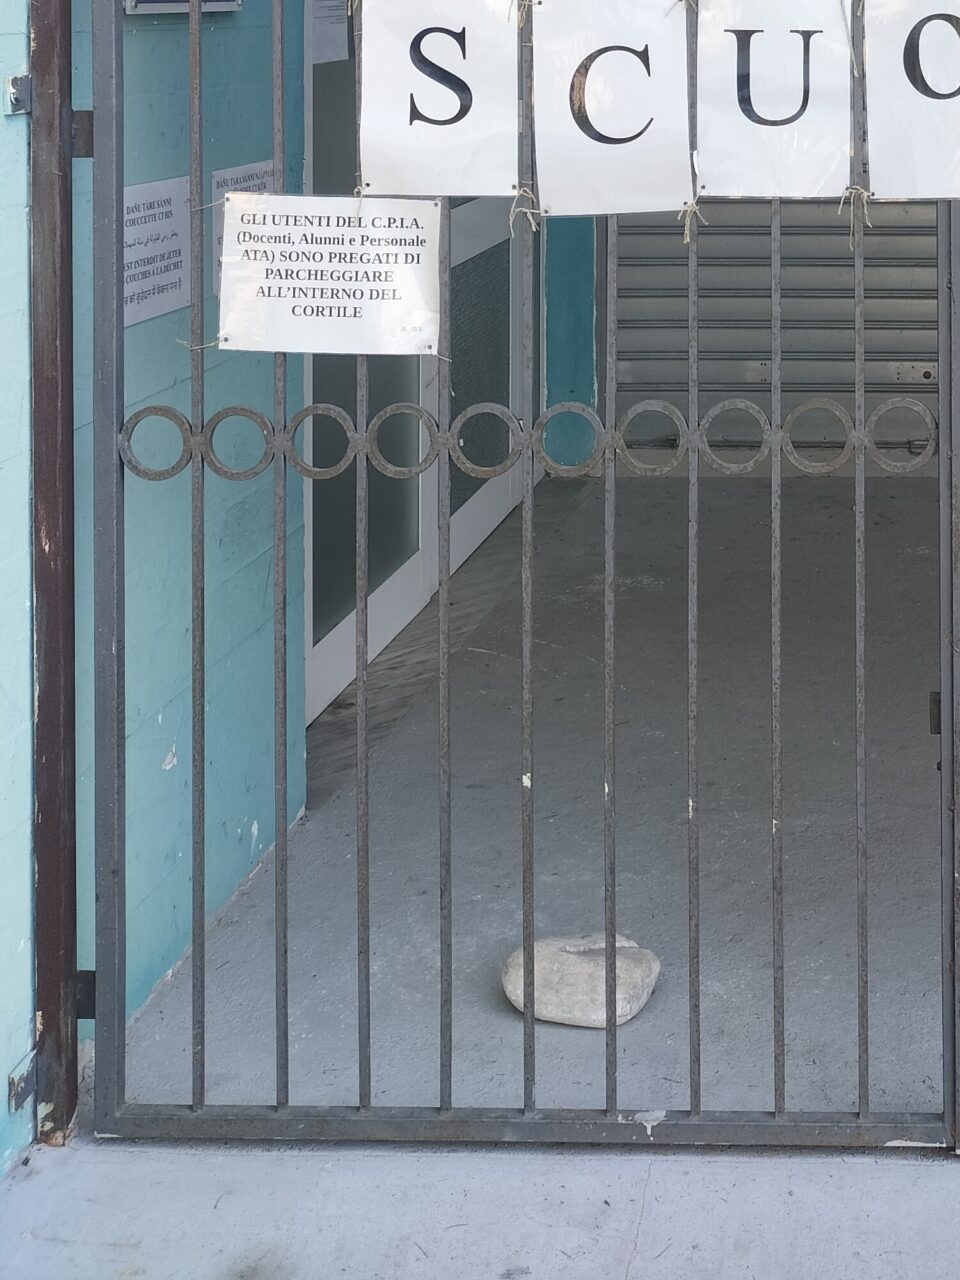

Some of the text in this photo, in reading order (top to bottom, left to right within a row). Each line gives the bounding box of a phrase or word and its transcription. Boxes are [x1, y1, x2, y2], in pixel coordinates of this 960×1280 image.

[240, 213, 424, 230] GLI UTENTI DEL C.P.I.A.
[236, 231, 427, 248] (Docenti, Alunni e Personale
[240, 248, 421, 265] ATA) SONO PREGATI DI
[264, 267, 394, 283] PARCHEGGIARE
[255, 286, 402, 301] ALL’INTERNO DEL
[292, 304, 363, 318] CORTILE
